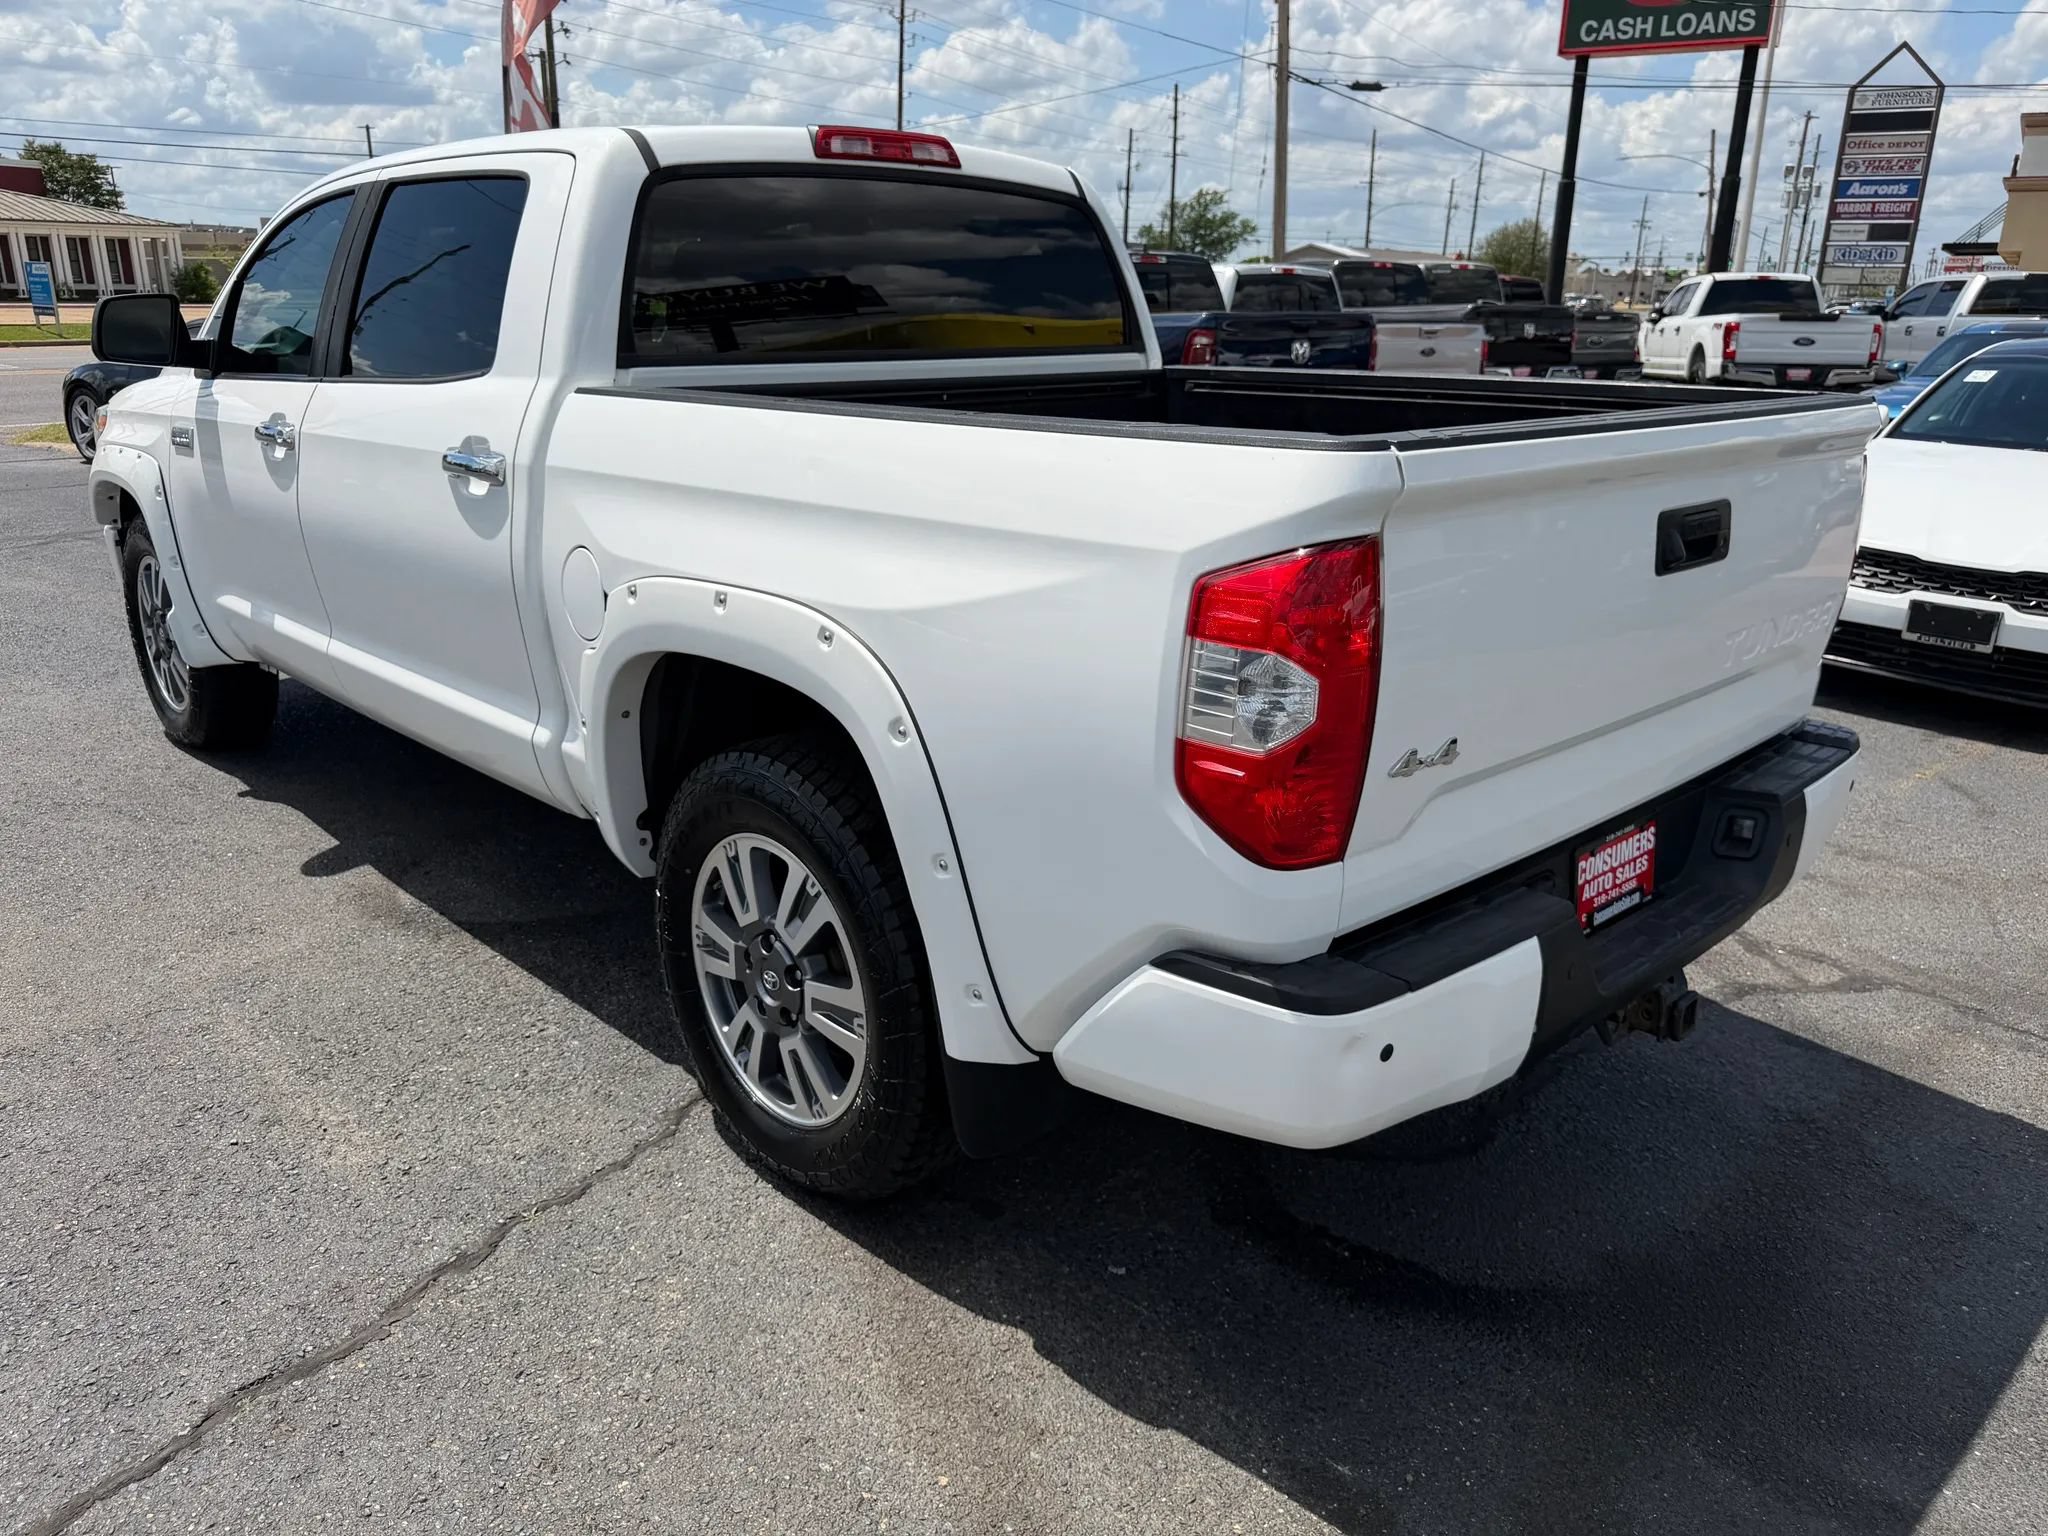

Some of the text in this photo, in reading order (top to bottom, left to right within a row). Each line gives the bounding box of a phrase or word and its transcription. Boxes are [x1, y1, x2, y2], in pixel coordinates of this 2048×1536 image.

[1580, 8, 1756, 42] CASH LOANS
[1874, 91, 1933, 99] JOHNSON'S
[1871, 97, 1933, 107] FURNITURE
[1847, 139, 1885, 149] Office
[1846, 182, 1909, 195] Aaron's
[1836, 201, 1912, 213] HARBOR FREIGHT
[1578, 826, 1656, 885] CONSUMERS
[1582, 854, 1648, 901] AUTO SALES
